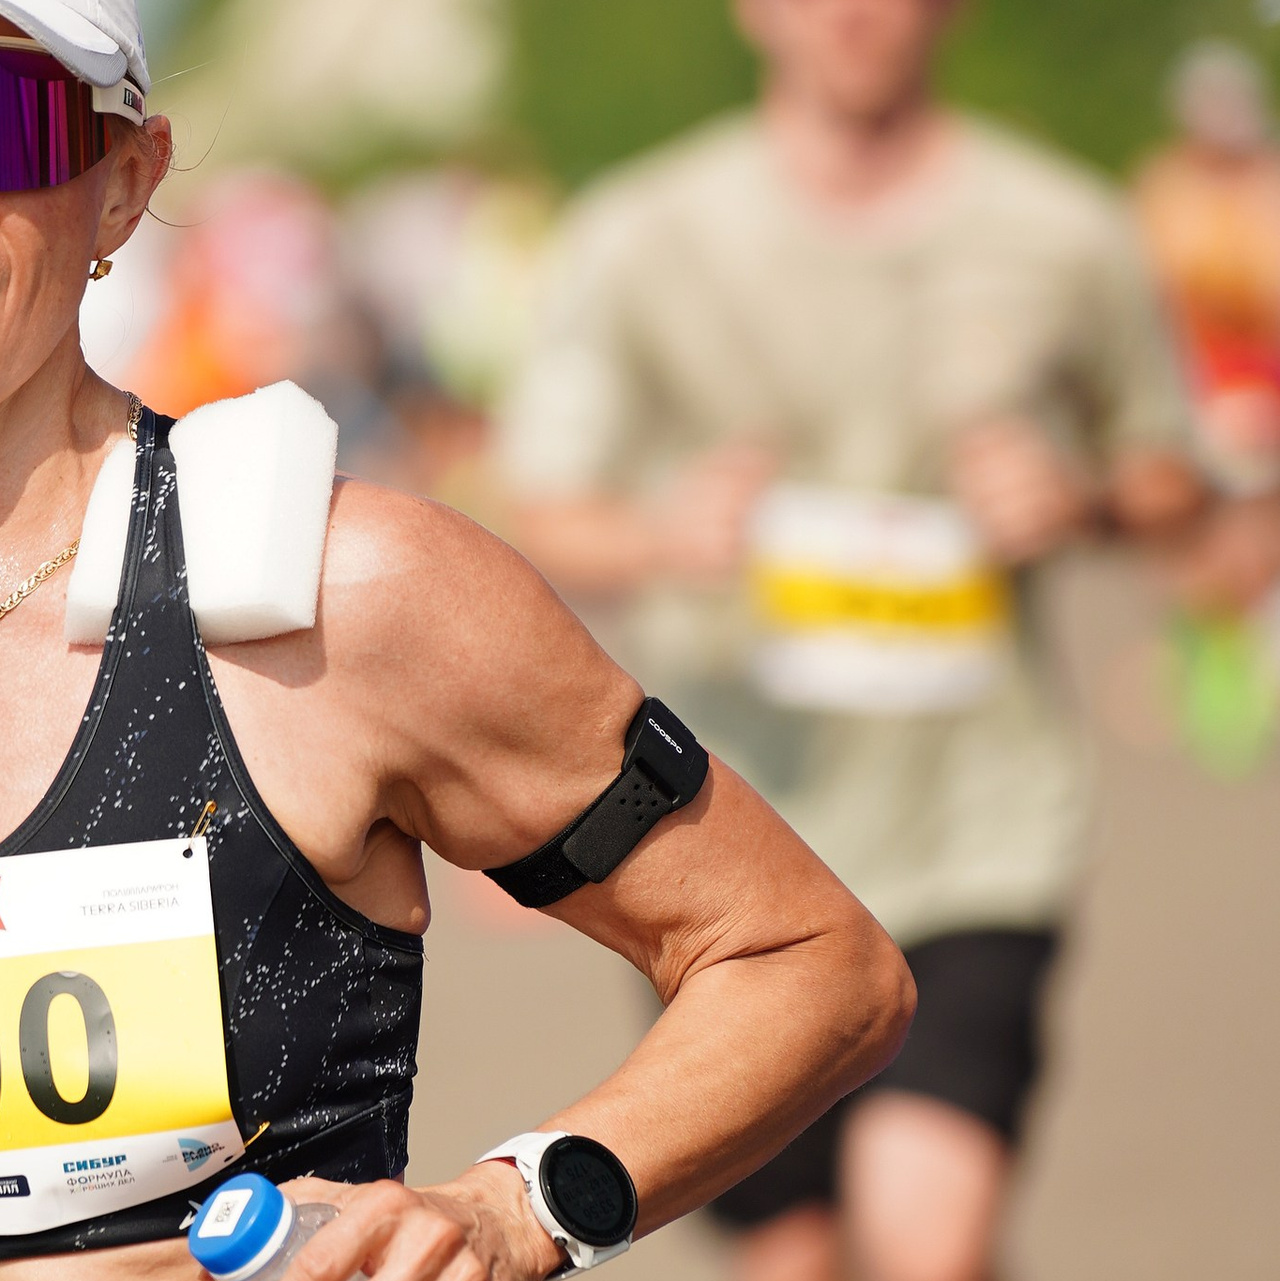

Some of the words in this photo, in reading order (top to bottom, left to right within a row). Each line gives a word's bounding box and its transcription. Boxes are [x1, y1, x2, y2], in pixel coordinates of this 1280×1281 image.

[649, 718, 682, 754] COOSPO
[81, 903, 126, 916] TERRA
[129, 897, 180, 912] SIBERIA
[63, 1154, 127, 1173] СИБУР
[67, 1169, 132, 1186] ФОРМУЛА
